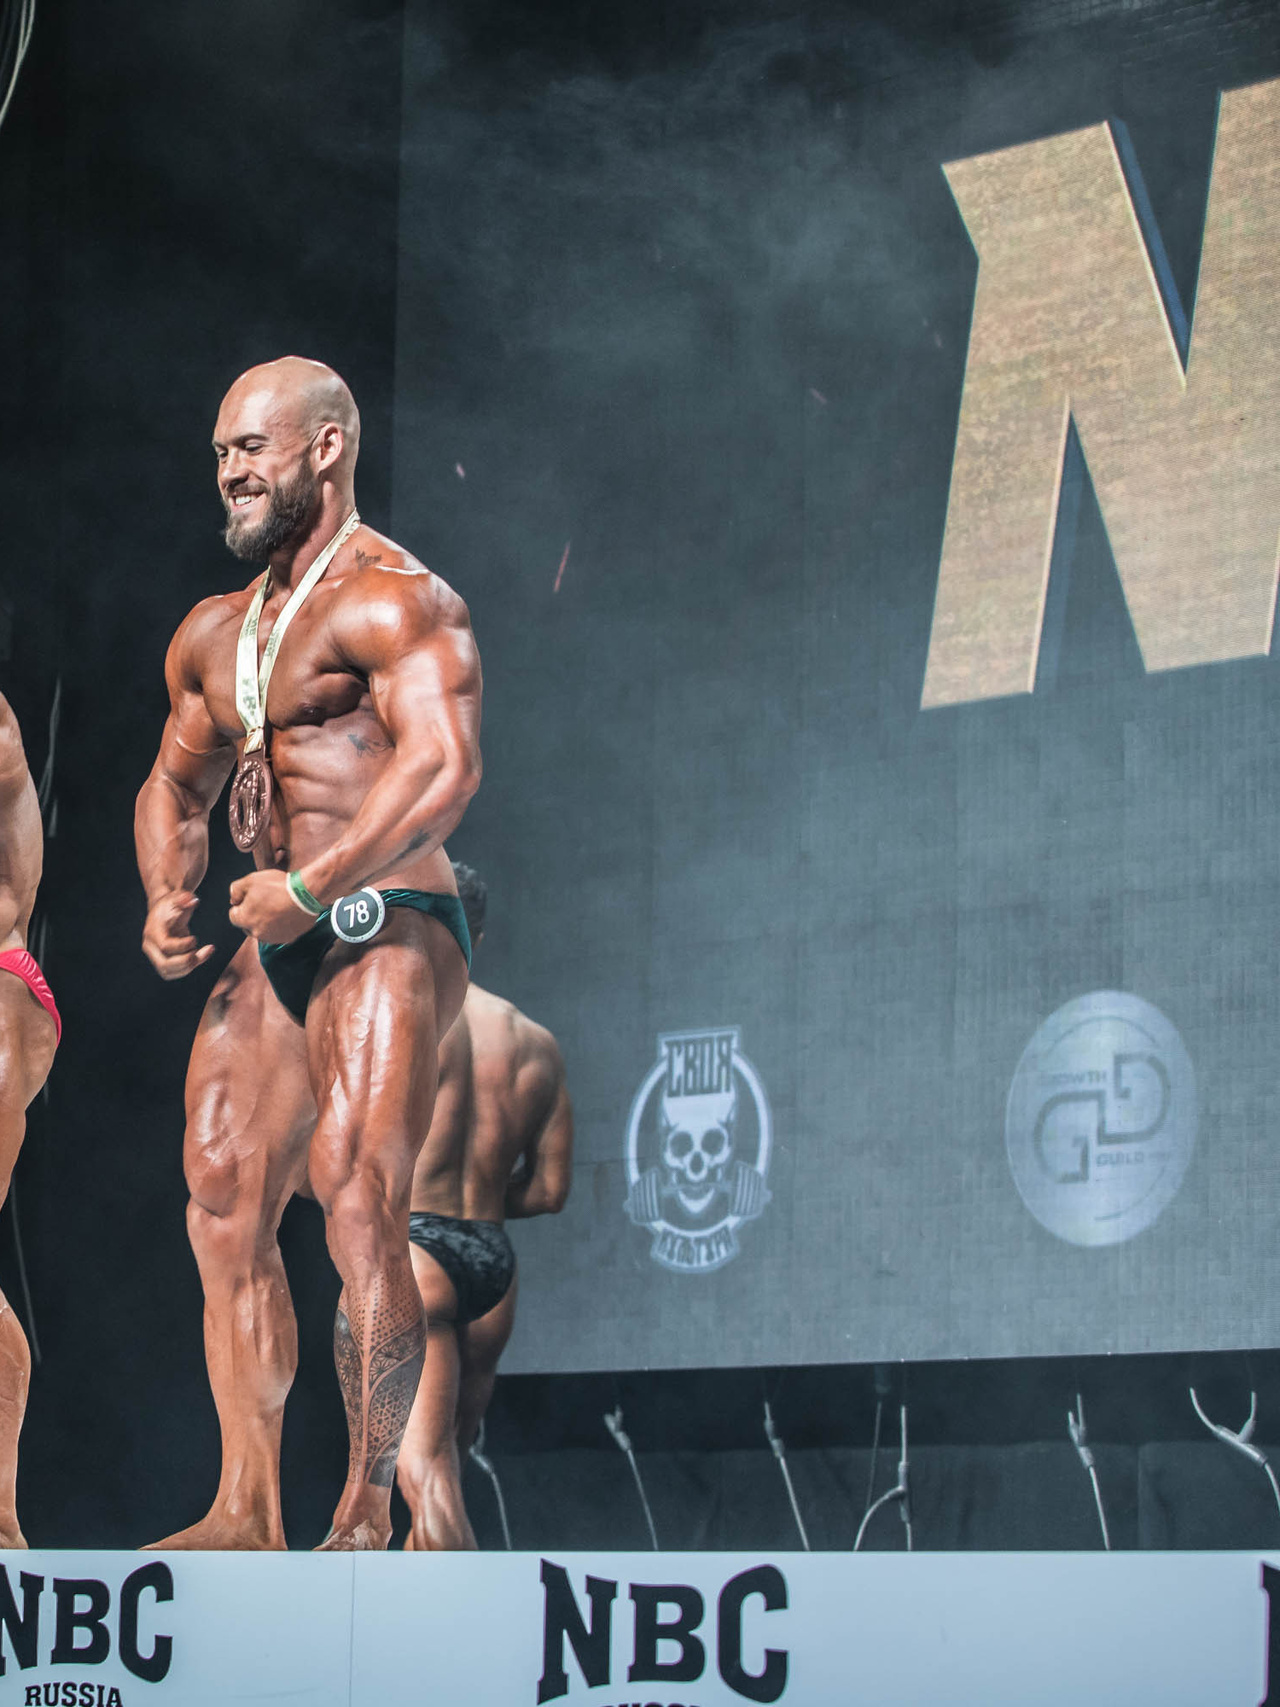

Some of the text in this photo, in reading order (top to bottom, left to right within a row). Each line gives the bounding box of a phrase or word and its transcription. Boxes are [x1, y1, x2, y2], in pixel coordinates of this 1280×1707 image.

[343, 899, 370, 929] 78
[536, 1557, 789, 1706] NBC
[24, 1681, 124, 1707] RUSSIA
